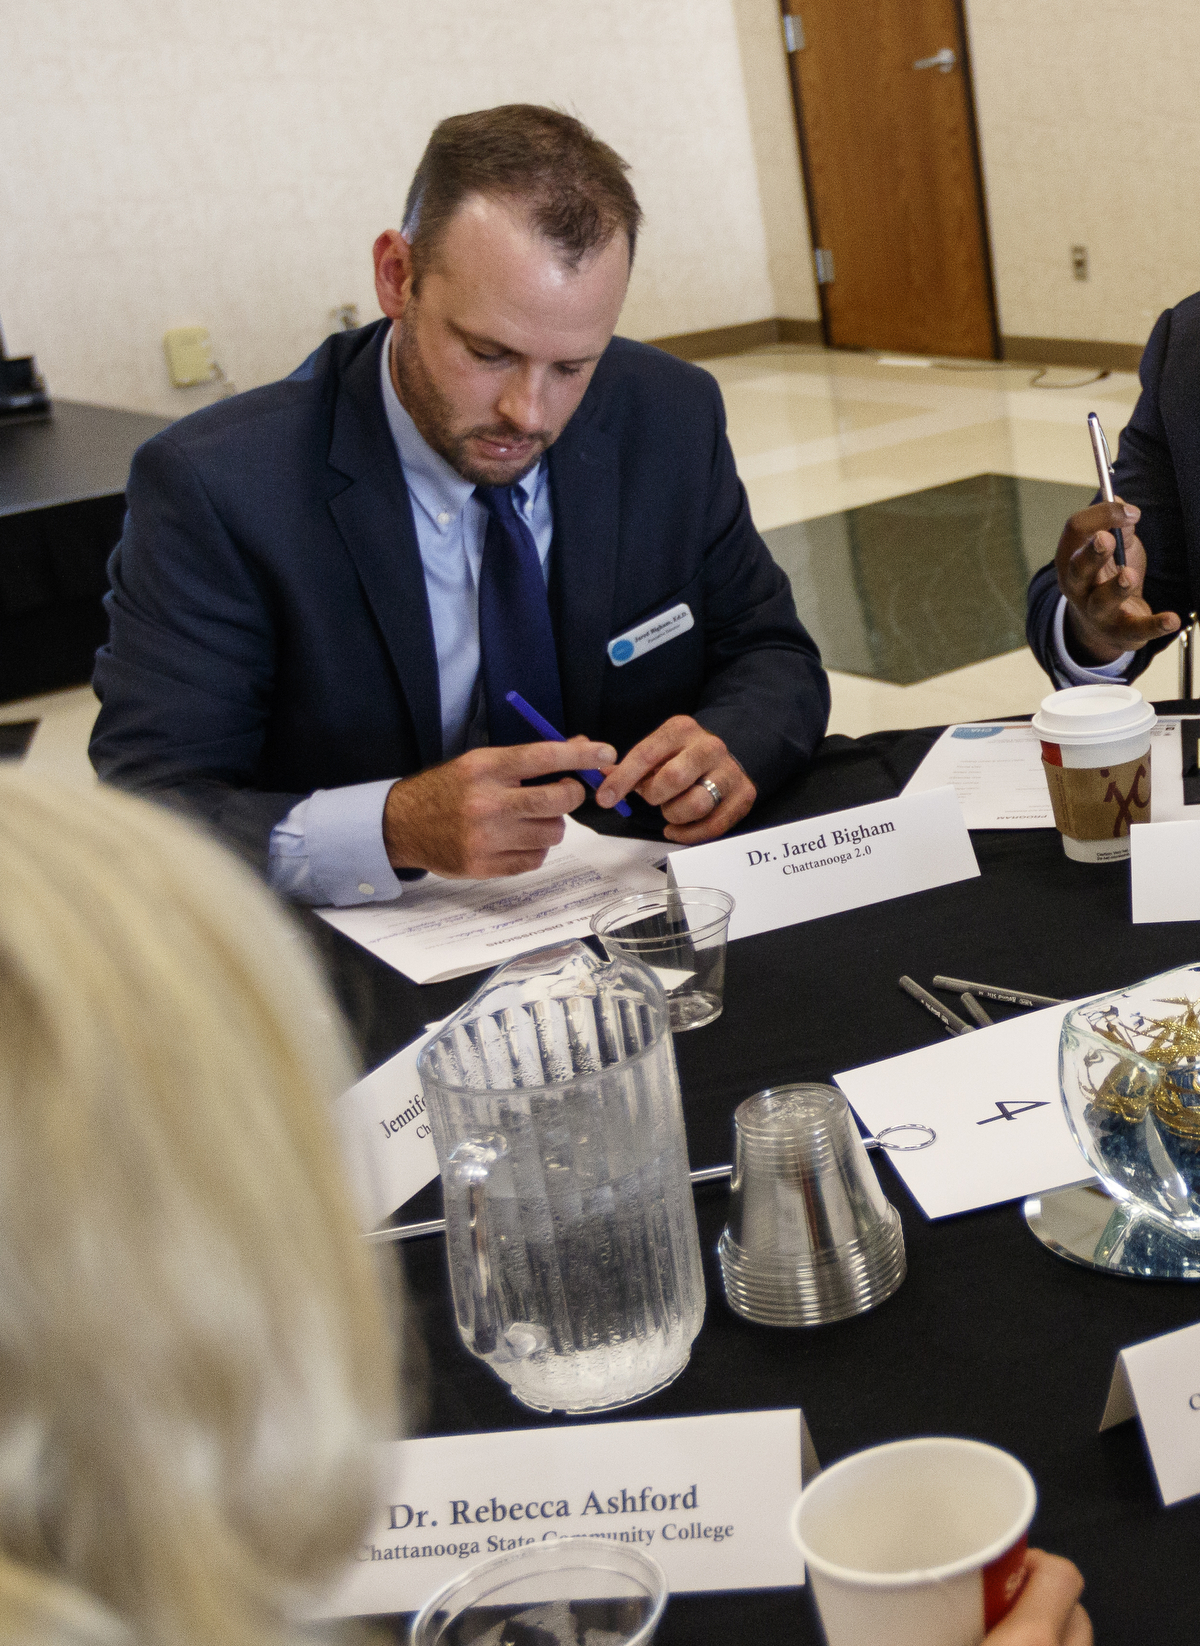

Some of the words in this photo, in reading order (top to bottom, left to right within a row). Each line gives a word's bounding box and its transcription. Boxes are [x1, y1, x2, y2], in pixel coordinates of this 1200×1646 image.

[746, 850, 778, 867] Dr.
[781, 834, 828, 859] Jared
[831, 819, 896, 845] Bigham
[782, 851, 853, 876] Chattanooga
[854, 845, 873, 859] 2.0
[486, 923, 563, 947] DISCUSSIONS
[976, 1101, 1052, 1125] 4
[416, 1124, 432, 1139] Ch
[387, 1503, 439, 1530] Dr.
[449, 1497, 571, 1527] Rebecca
[580, 1484, 700, 1517] Ashford
[486, 1530, 536, 1553] State
[661, 1521, 735, 1543] College
